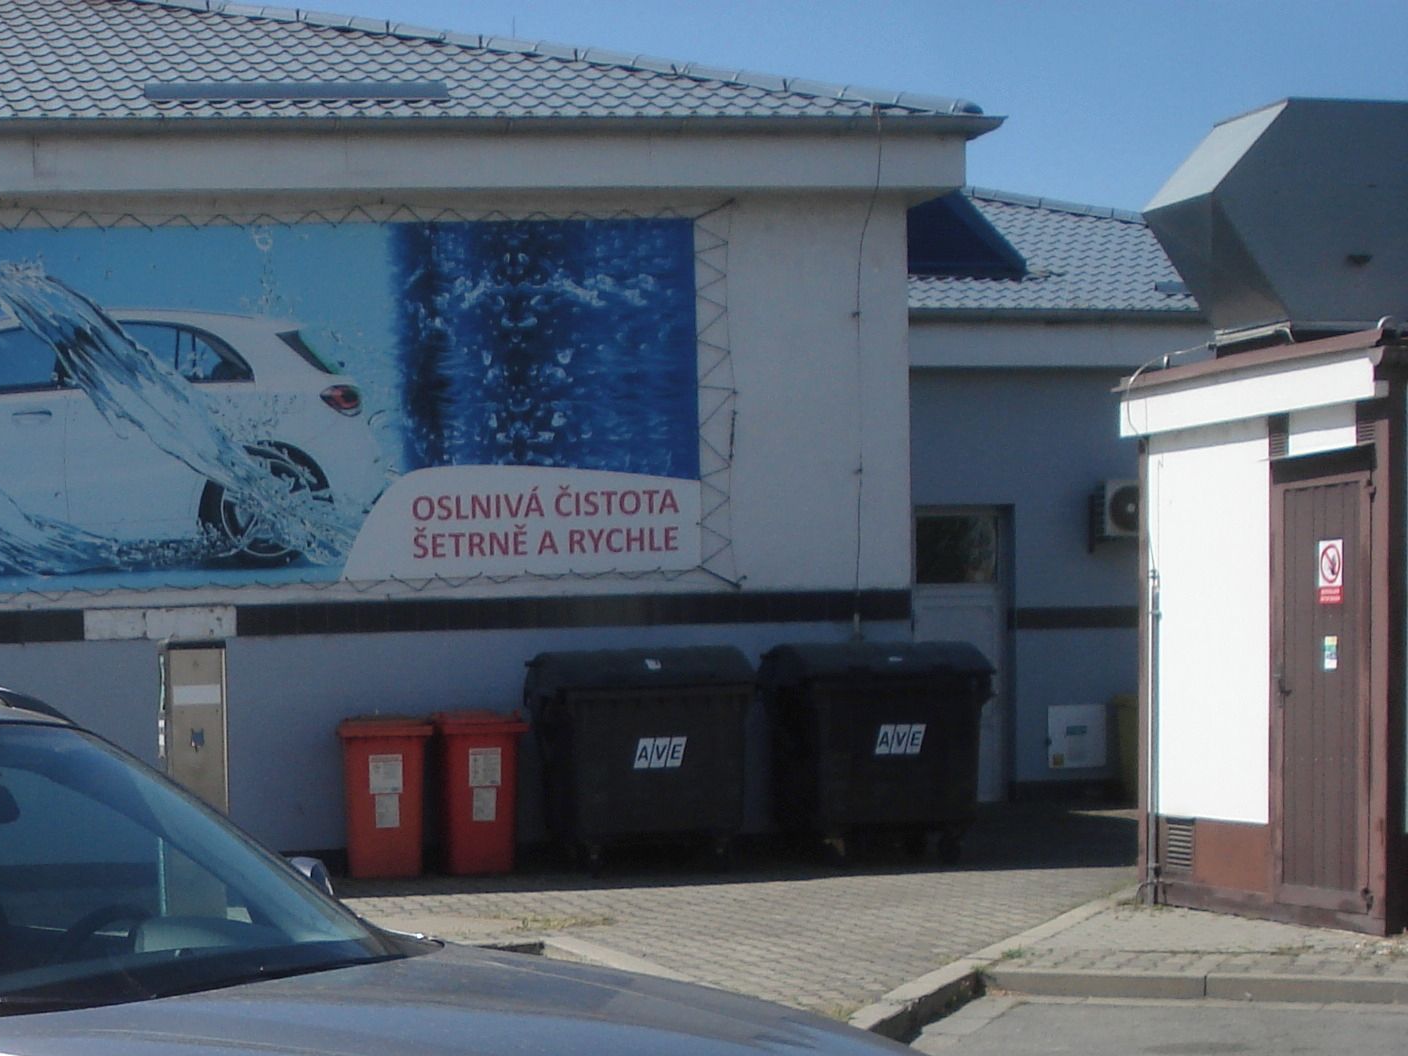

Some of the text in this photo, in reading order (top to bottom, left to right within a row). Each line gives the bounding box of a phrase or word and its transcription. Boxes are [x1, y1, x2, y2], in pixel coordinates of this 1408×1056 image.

[412, 484, 679, 521] OSLNIVÁ ČISTOTA
[413, 524, 679, 559] ŠETRNĚ A RYCHLE
[636, 742, 684, 763] AVE
[877, 729, 923, 749] AVE
